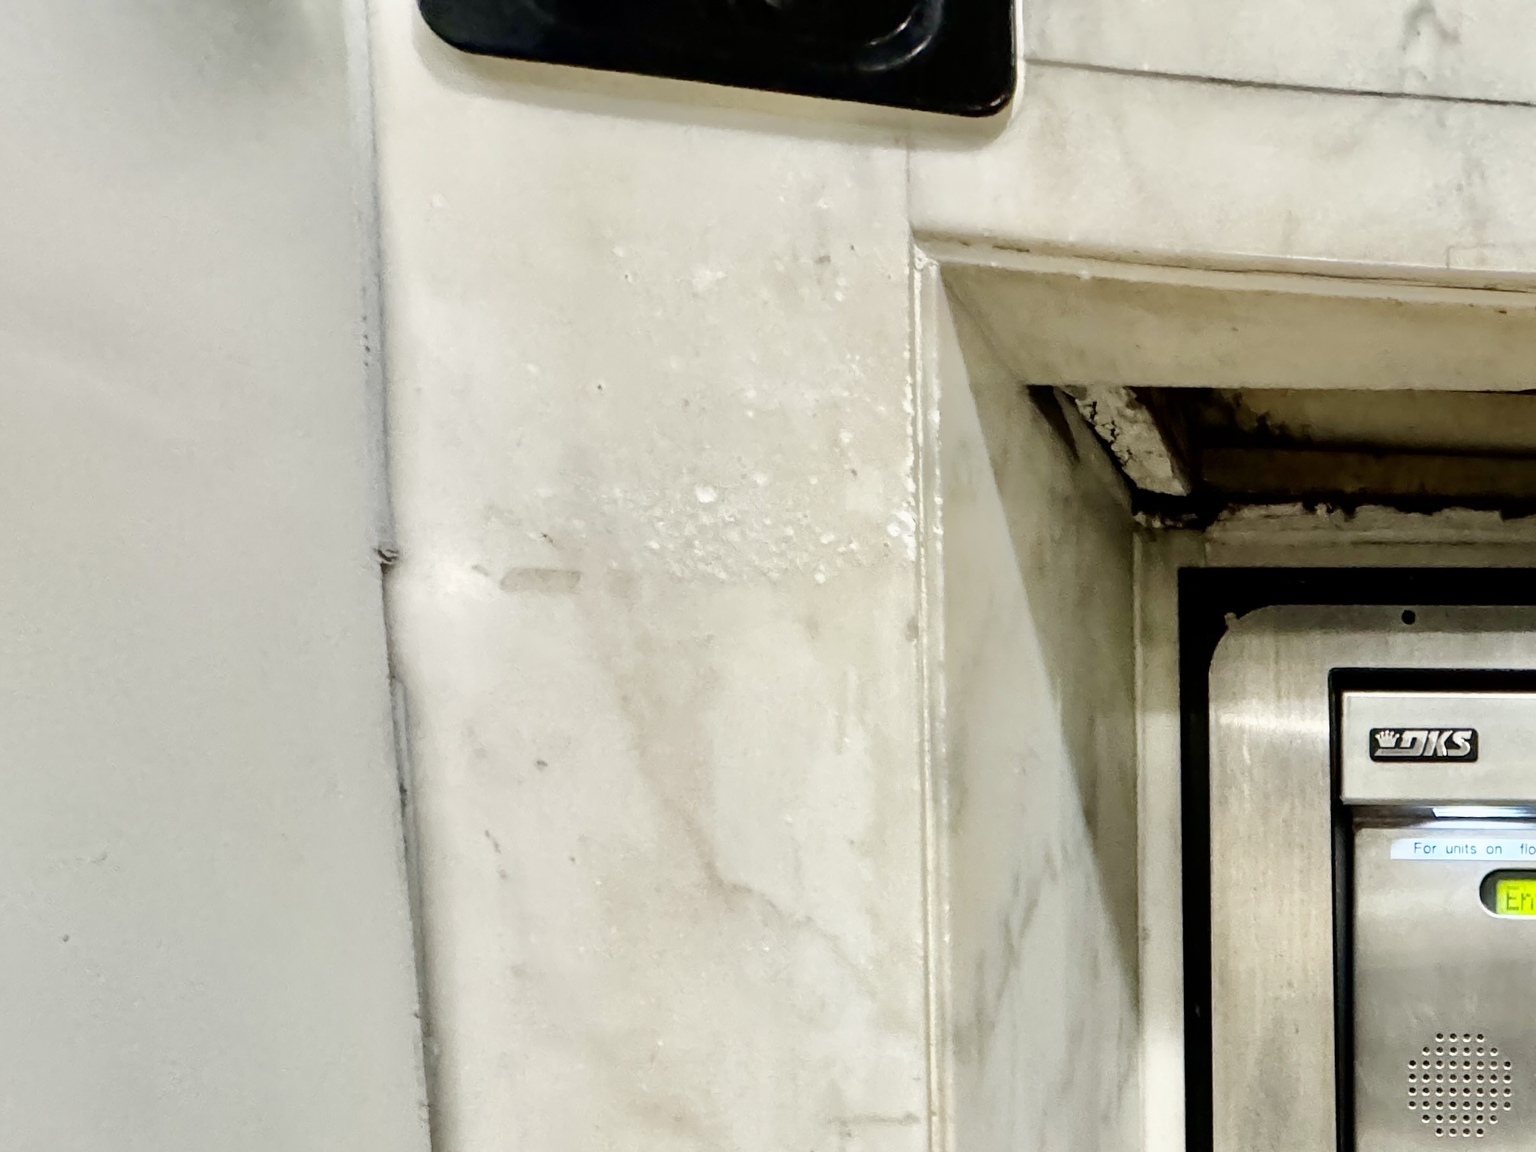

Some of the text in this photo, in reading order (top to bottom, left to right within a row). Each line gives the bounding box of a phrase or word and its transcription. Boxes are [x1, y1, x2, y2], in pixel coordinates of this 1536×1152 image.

[1374, 731, 1472, 757] DKS
[1413, 842, 1437, 855] For
[1445, 842, 1477, 855] units
[1486, 846, 1503, 855] on
